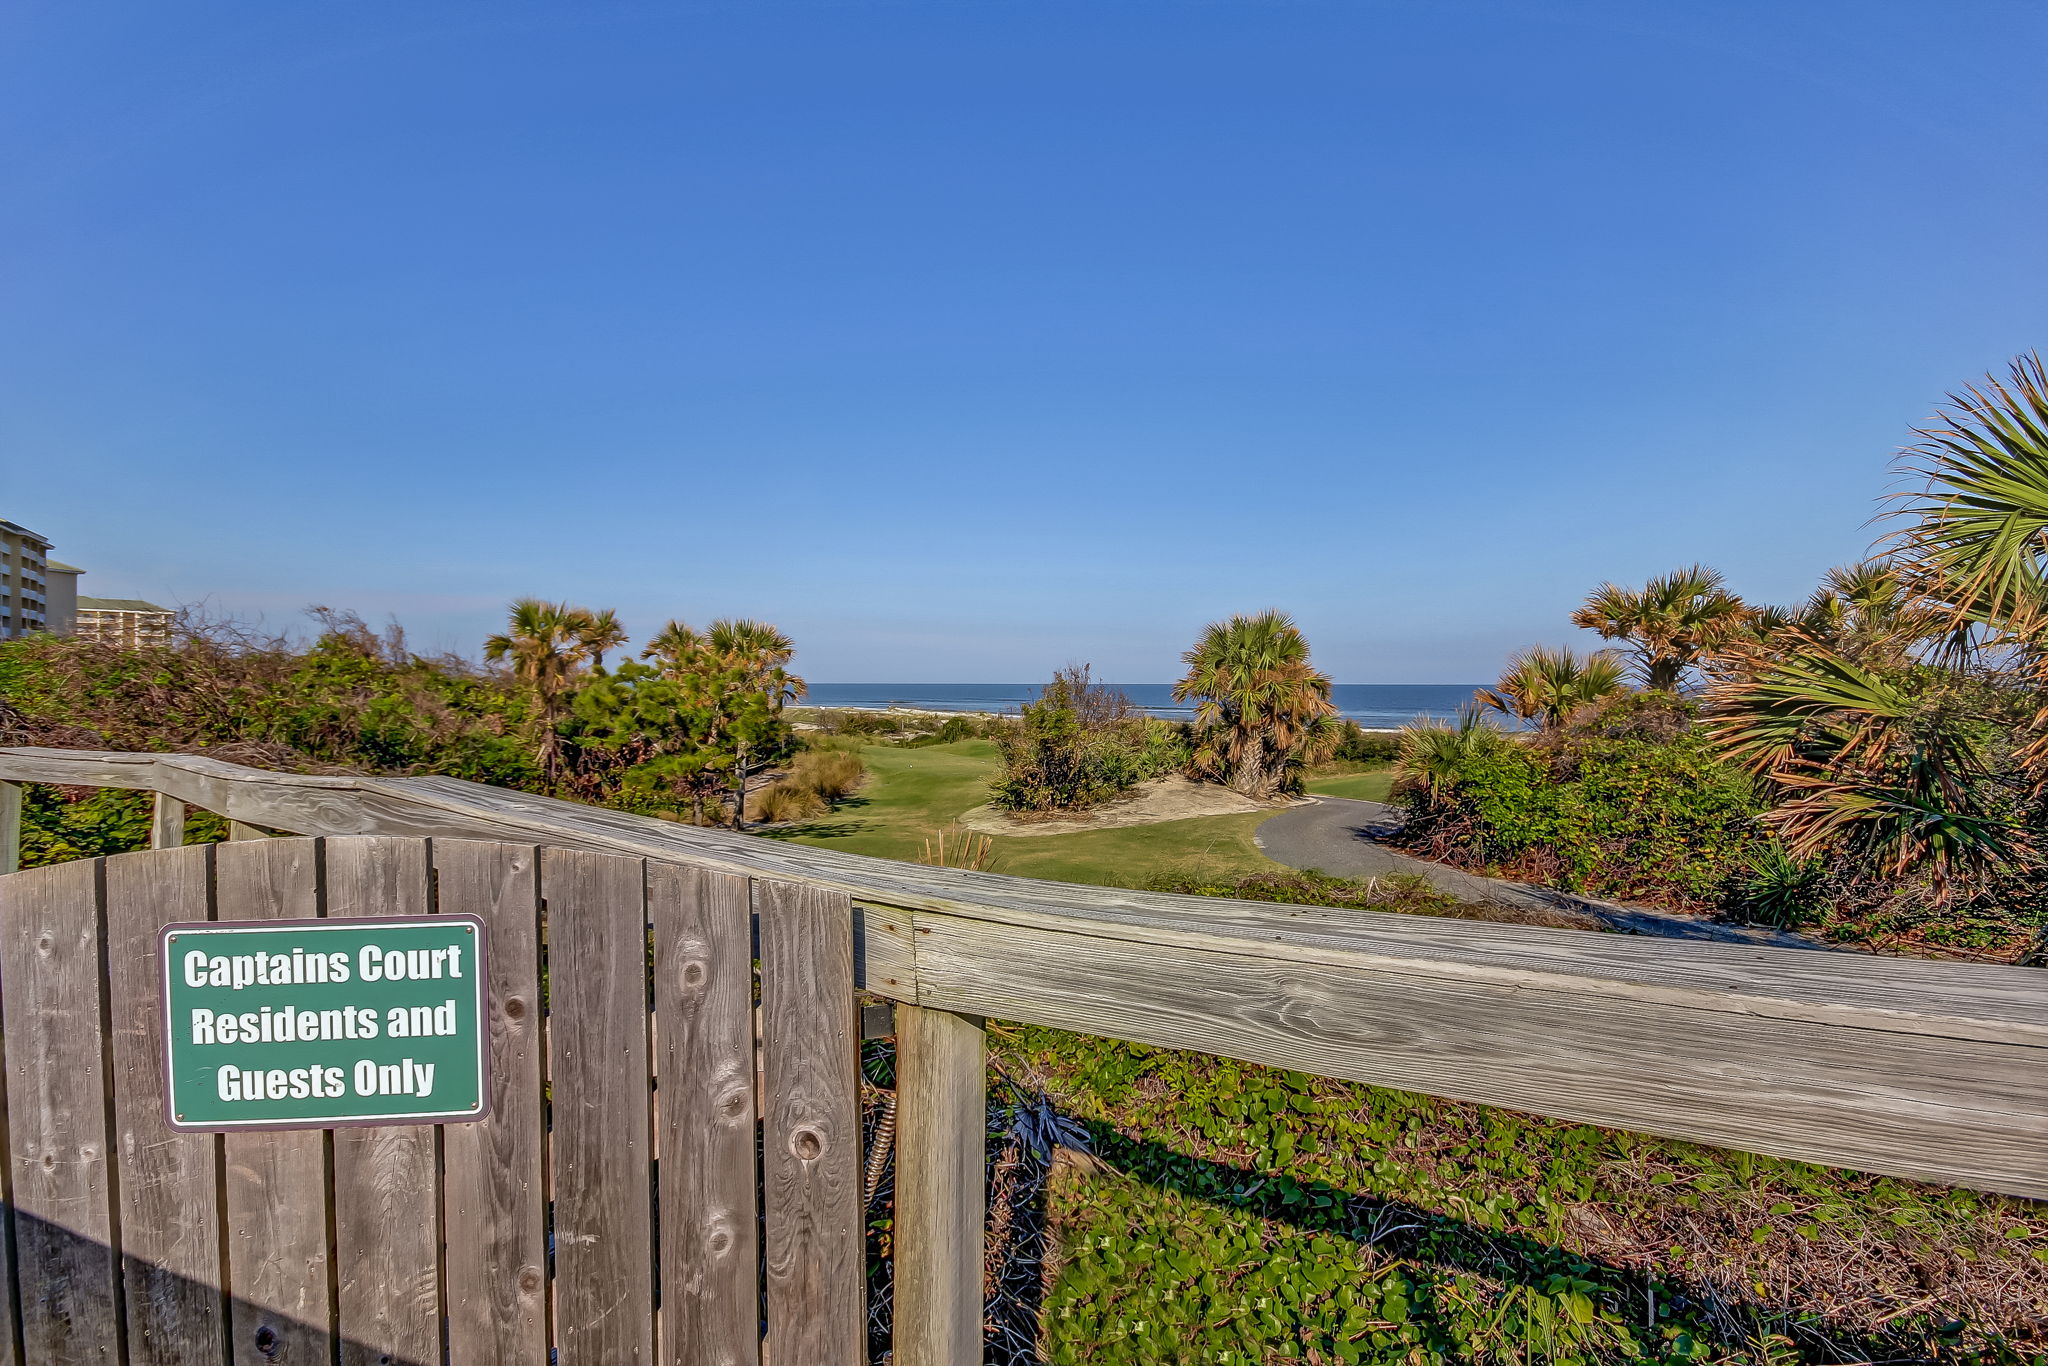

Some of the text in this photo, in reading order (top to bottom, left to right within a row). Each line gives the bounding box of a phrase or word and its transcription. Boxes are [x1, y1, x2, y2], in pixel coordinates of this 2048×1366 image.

[184, 944, 463, 989] Captains Court
[191, 999, 457, 1045] Residents and
[217, 1058, 435, 1102] Guests Only
